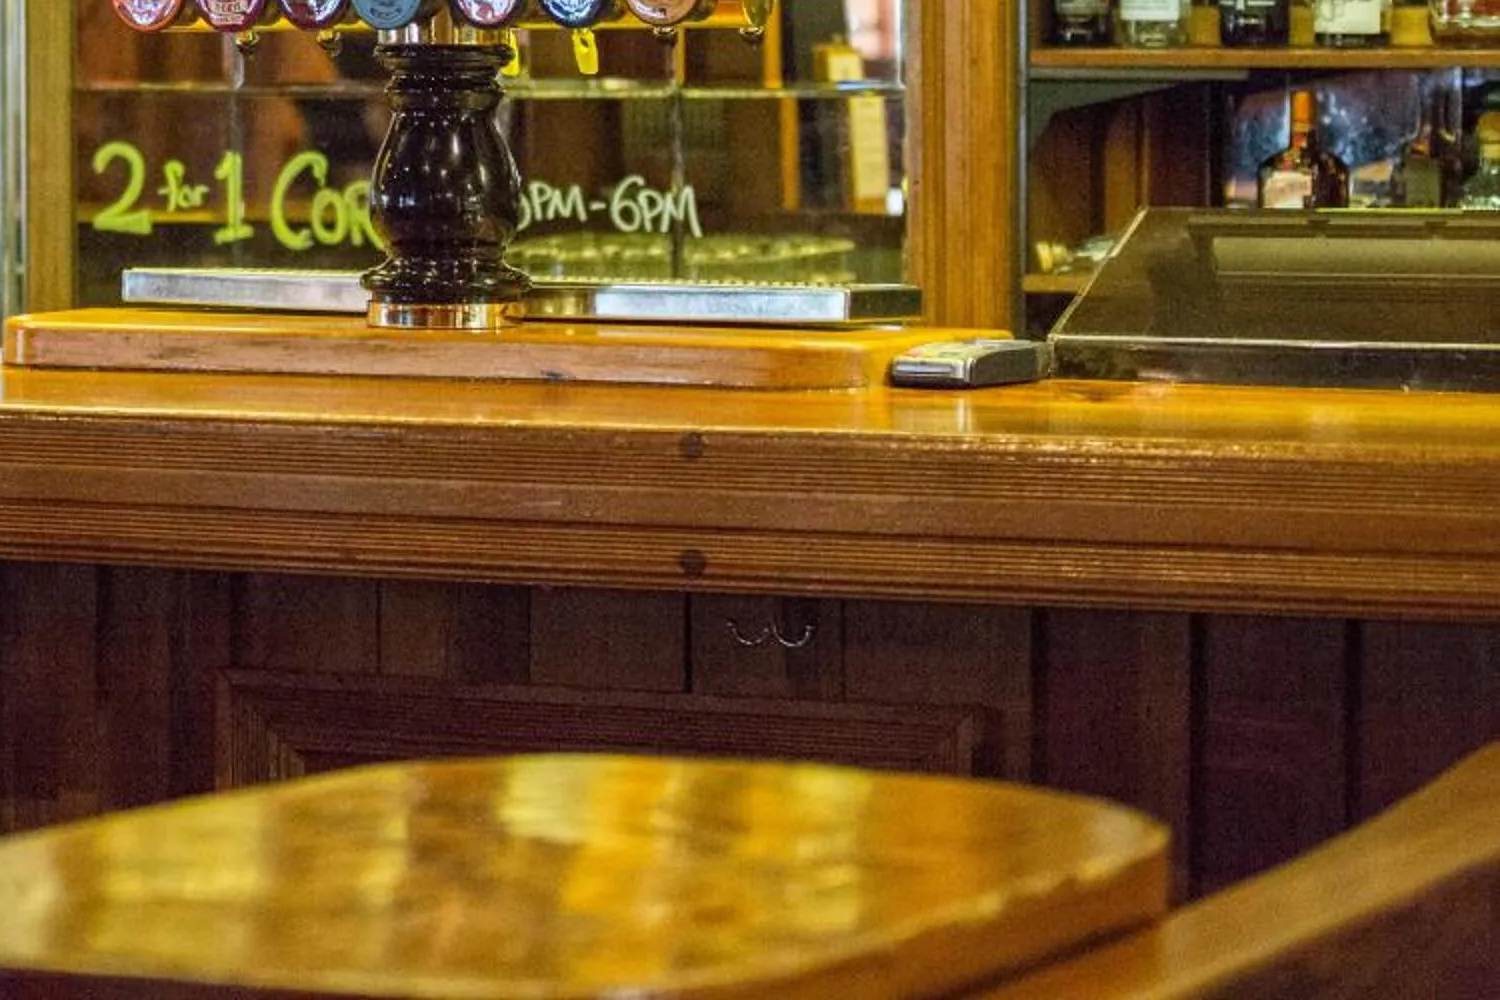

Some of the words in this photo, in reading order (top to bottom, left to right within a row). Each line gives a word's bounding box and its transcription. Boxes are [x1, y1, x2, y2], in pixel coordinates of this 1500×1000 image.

[92, 140, 152, 235] 2
[157, 160, 210, 213] for
[213, 151, 254, 245] 1
